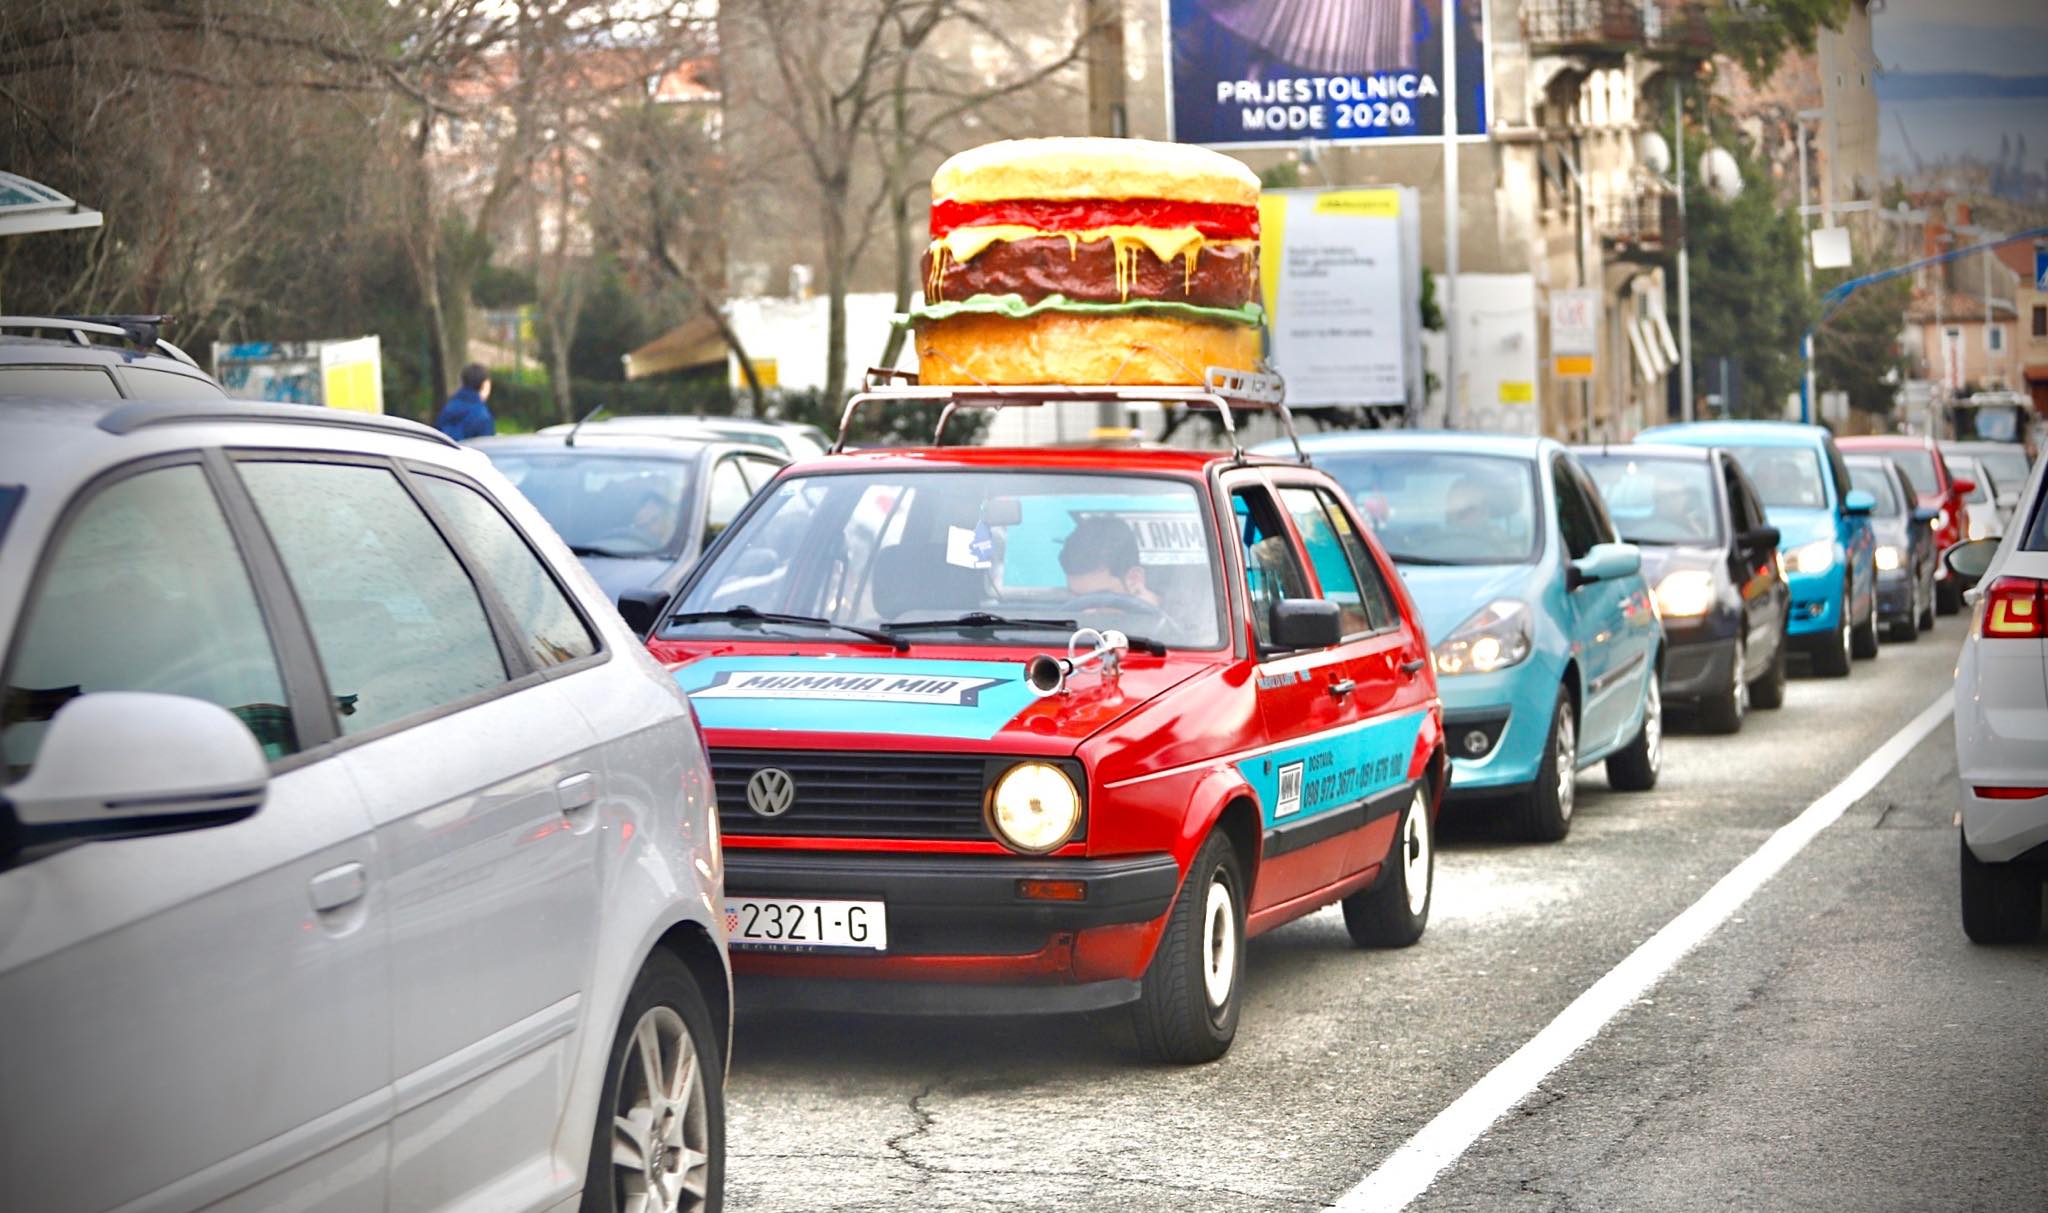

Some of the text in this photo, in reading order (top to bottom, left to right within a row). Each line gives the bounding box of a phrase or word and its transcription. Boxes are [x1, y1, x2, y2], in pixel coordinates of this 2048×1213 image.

[1217, 75, 1438, 103] PRIJESTOLNICA
[1242, 105, 1327, 130] MODE
[738, 676, 958, 693] MAMMA MIA
[742, 903, 868, 942] 2321-G
